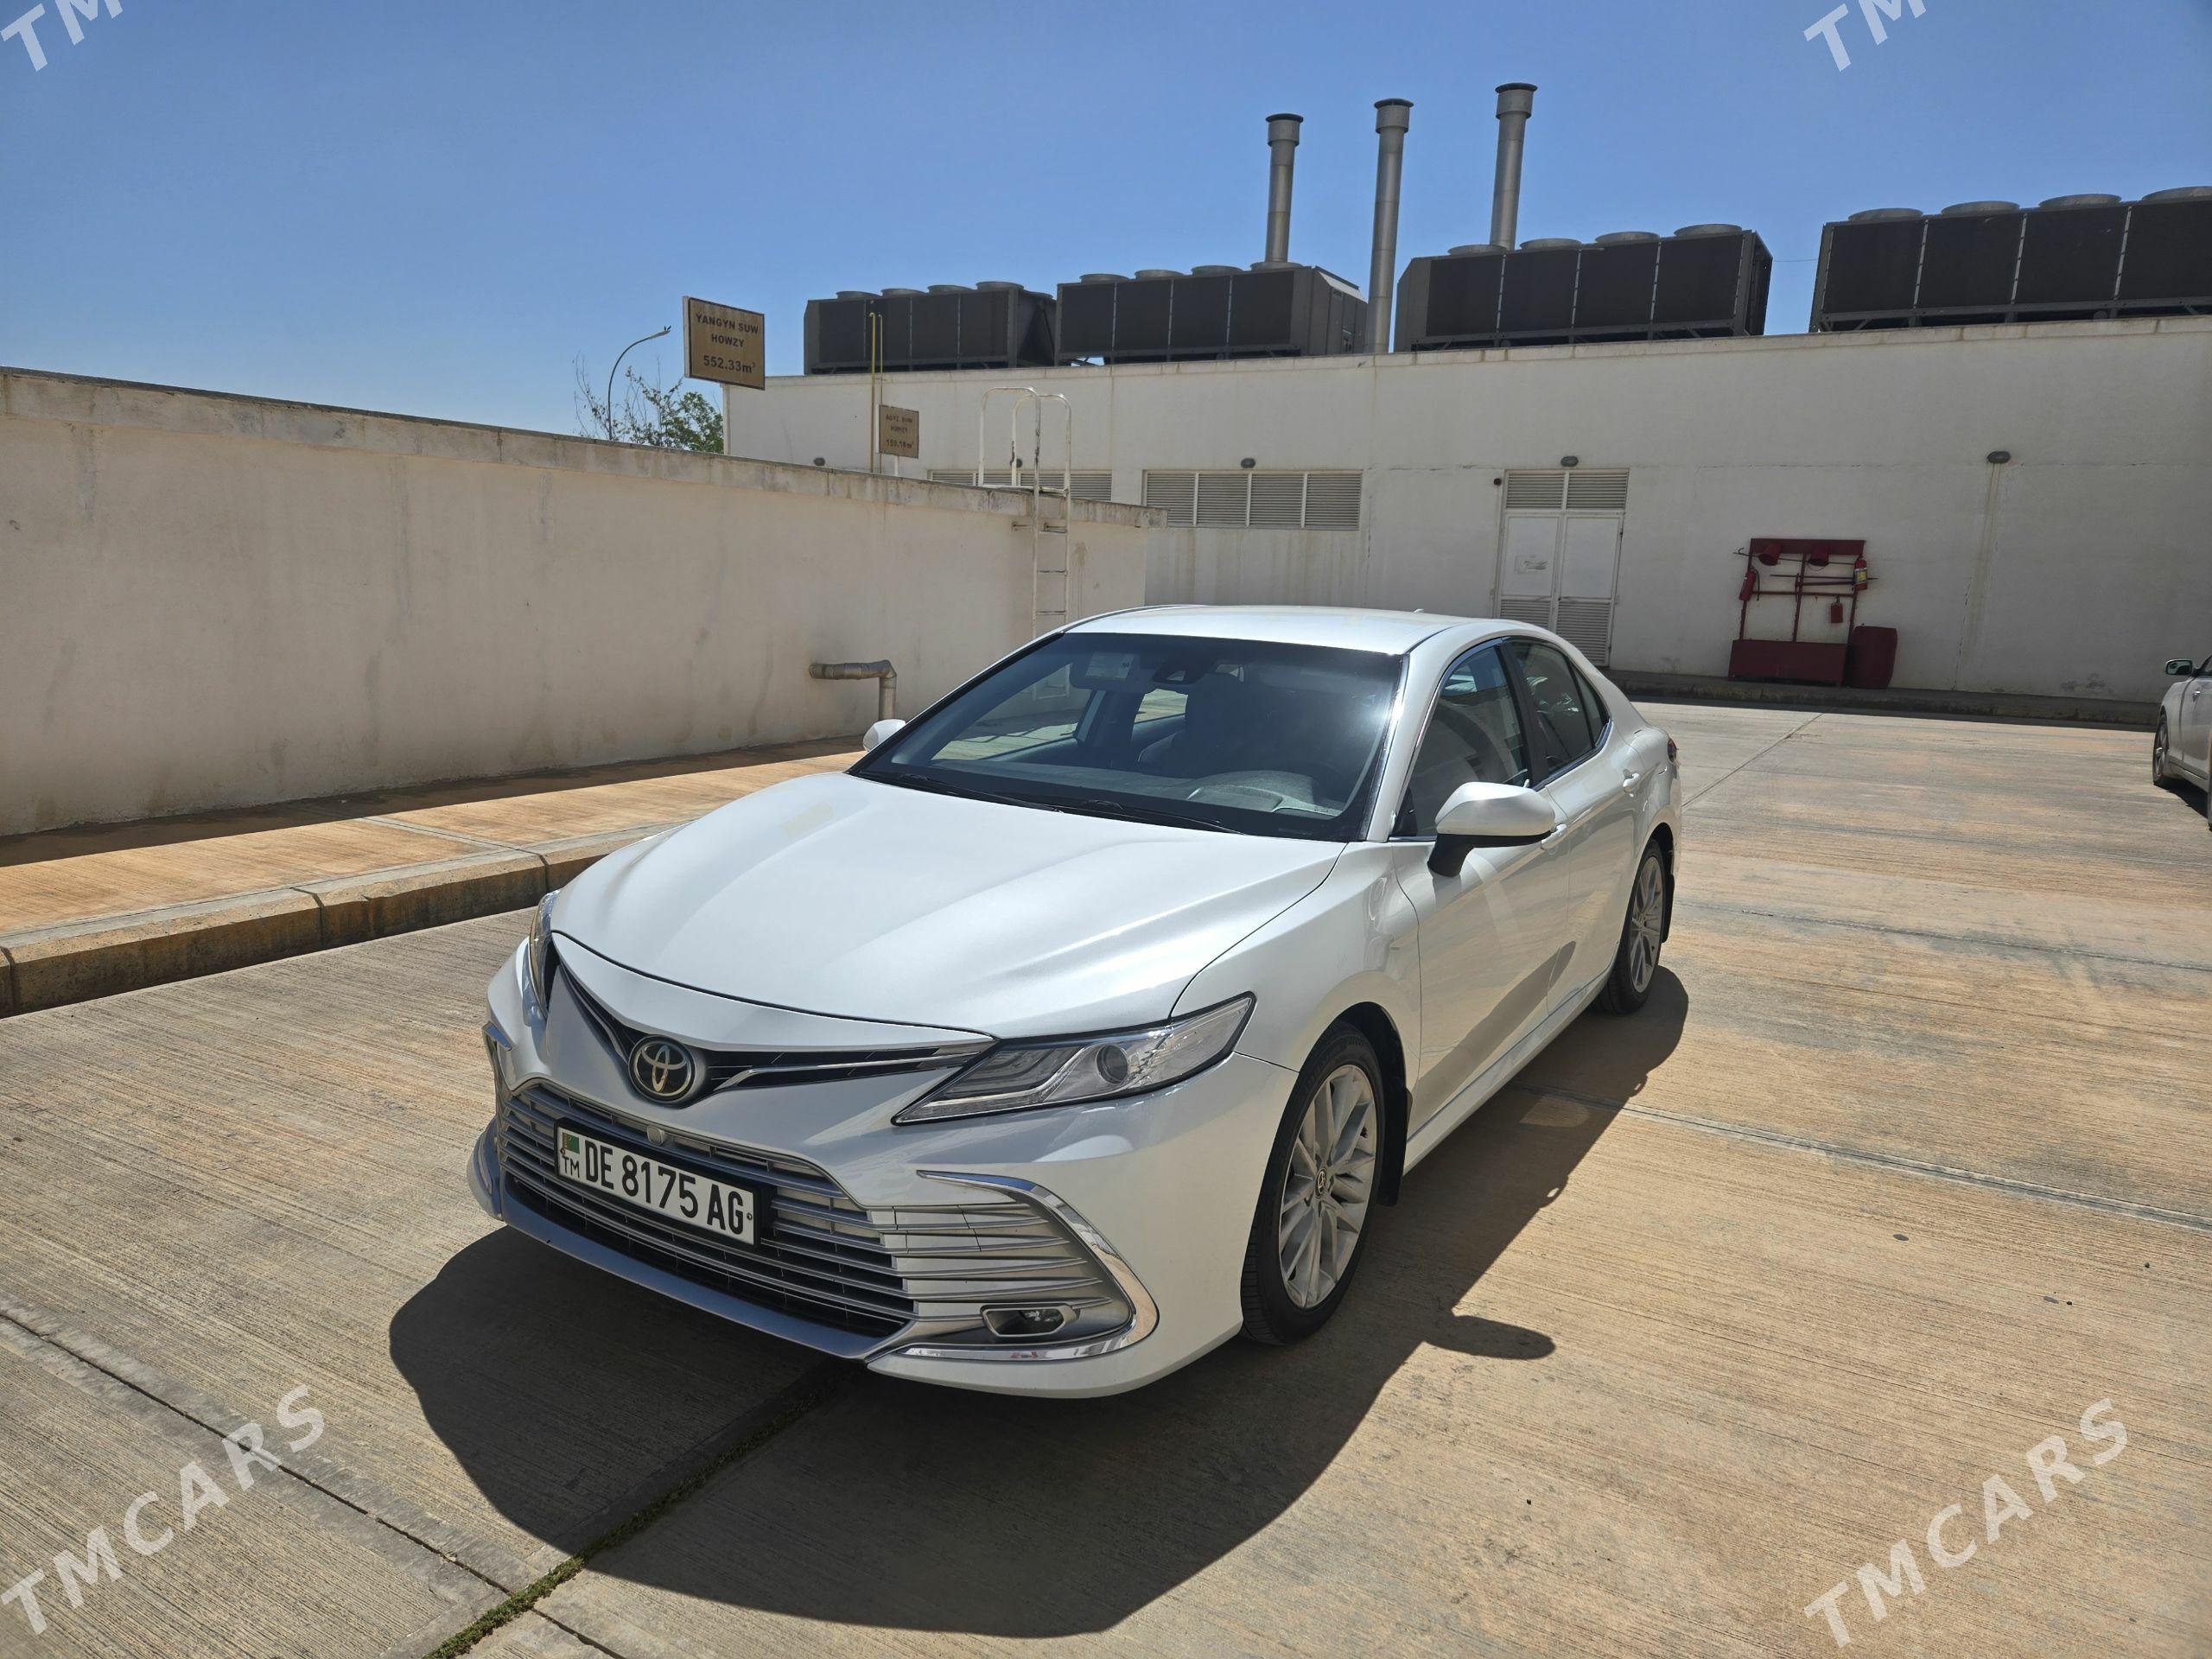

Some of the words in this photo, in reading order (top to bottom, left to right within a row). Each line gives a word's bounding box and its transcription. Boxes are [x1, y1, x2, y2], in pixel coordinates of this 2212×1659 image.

[739, 323, 759, 334] SUW
[711, 334, 744, 347] HOWZY
[562, 1156, 580, 1178] TM
[585, 1140, 613, 1190] DE
[622, 1154, 698, 1218] 8175
[707, 1184, 744, 1235] AG
